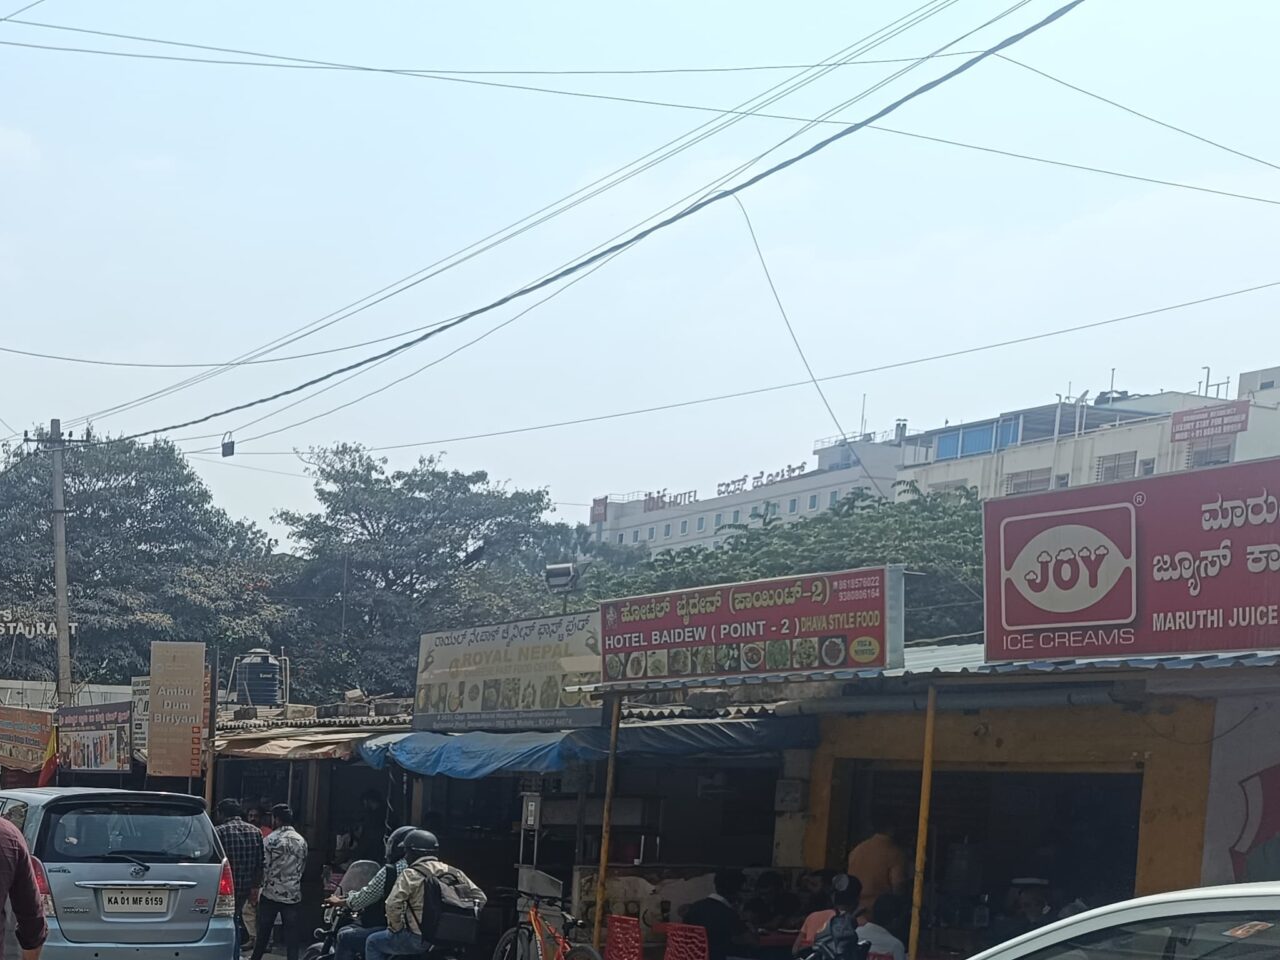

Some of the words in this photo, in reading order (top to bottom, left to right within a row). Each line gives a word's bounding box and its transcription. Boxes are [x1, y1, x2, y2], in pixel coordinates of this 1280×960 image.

[668, 490, 699, 508] HOTEL
[1201, 487, 1280, 531] ಮಾರು
[1024, 545, 1109, 593] JOY
[1152, 539, 1231, 597] ಜ್ಯೂಸ್
[801, 614, 828, 632] DHAVA
[828, 612, 855, 630] STYLE
[856, 610, 880, 628] FOOD
[1152, 608, 1223, 631] MARUTHI
[1229, 605, 1278, 627] JUICE
[605, 632, 648, 649] HOTEL
[651, 626, 707, 645] BAIDEW
[720, 621, 766, 638] POINT
[1003, 634, 1034, 650] ICE
[1039, 628, 1135, 648] CREAMS
[462, 649, 512, 667] ROYAL
[518, 642, 574, 661] NEPAL
[157, 686, 196, 697] Ambur
[162, 700, 191, 710] Dum
[152, 713, 200, 726] Biriyani
[107, 897, 119, 905] KA
[121, 897, 130, 905] 01
[132, 897, 143, 905] MF
[144, 897, 164, 906] 6159
